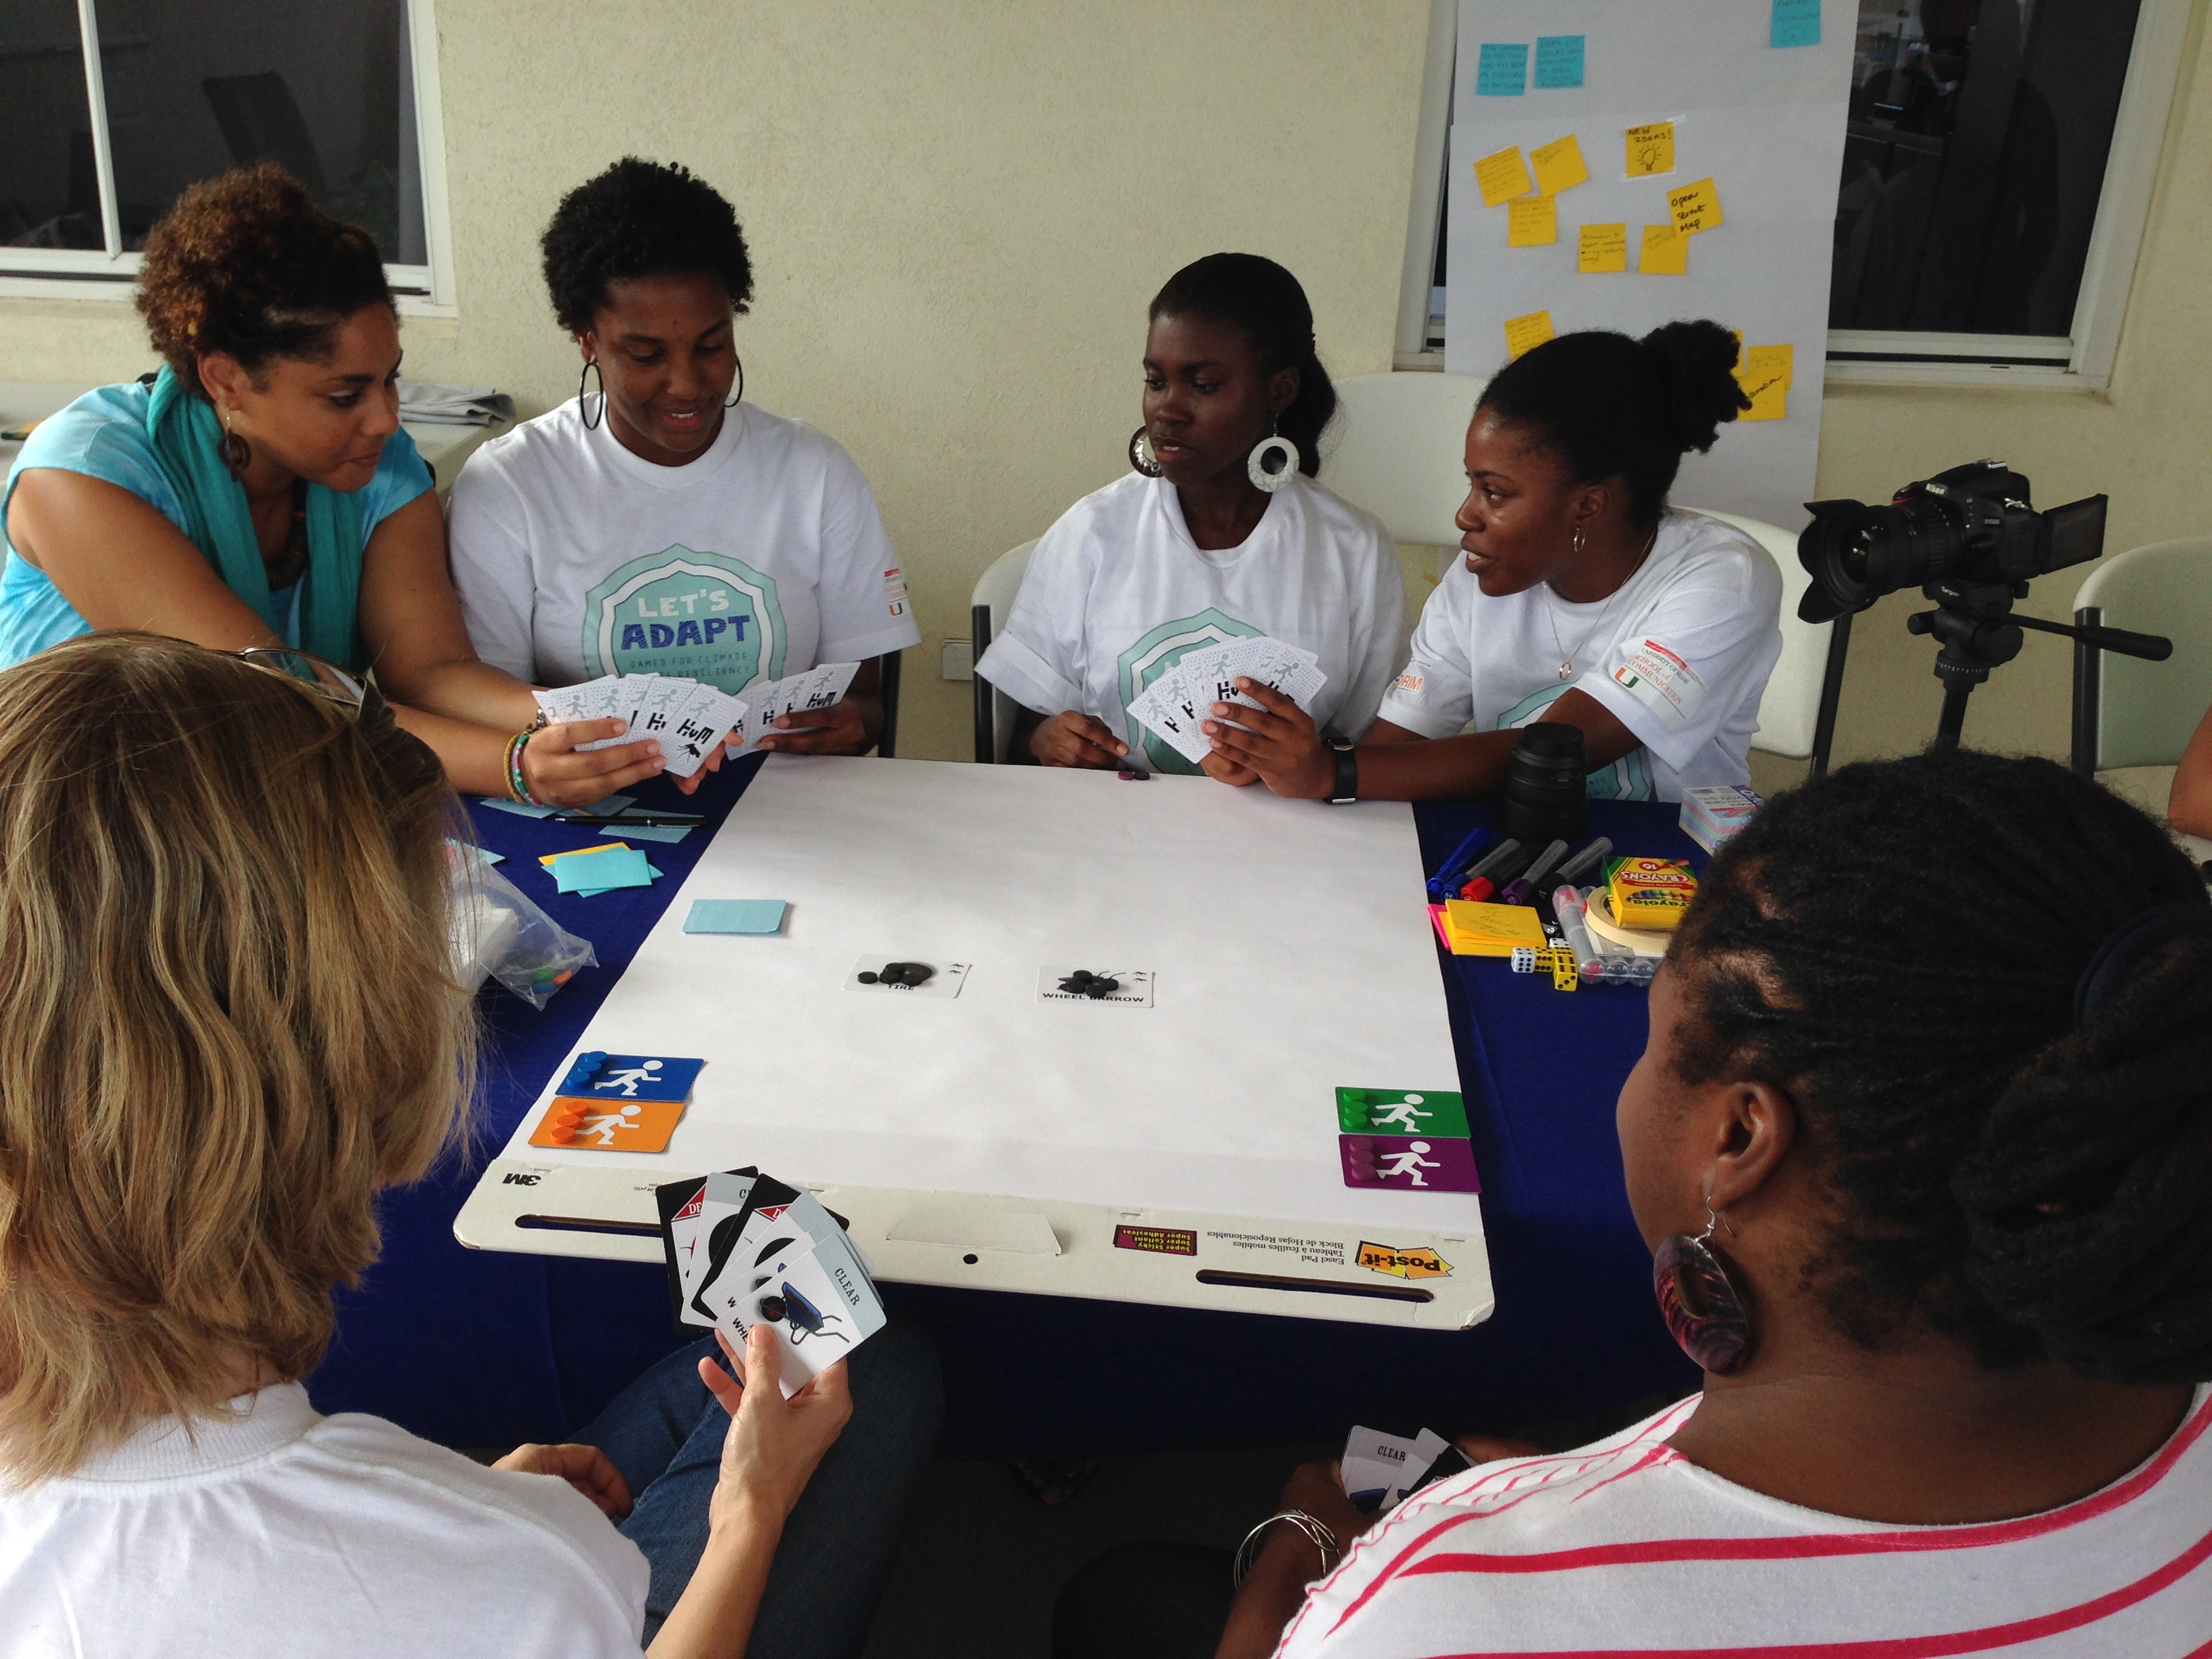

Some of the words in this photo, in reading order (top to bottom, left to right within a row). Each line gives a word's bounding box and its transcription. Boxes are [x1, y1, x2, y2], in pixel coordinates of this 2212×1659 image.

[638, 589, 730, 617] LET'S
[621, 615, 750, 651] ADAPT
[630, 659, 666, 669] GAMES
[672, 657, 693, 665] FOR
[698, 653, 747, 663] CLIMATE
[1641, 647, 1671, 666] UNIVERSITY
[678, 665, 750, 678] RESILIENCY
[1633, 655, 1662, 675] SCHOOL
[1627, 659, 1683, 704] COMMUNICATION
[1620, 871, 1688, 882] CRAYONS
[502, 1173, 541, 1186] 3M
[1122, 1229, 1164, 1237] Adhesivas
[1207, 1231, 1275, 1244] Reposicionables
[1233, 1241, 1266, 1249] mobiles
[1278, 1237, 1303, 1246] Hojas
[1269, 1244, 1299, 1253] feuilles
[1310, 1248, 1345, 1257] Tableau
[1321, 1256, 1345, 1265] Easel
[1364, 1254, 1441, 1271] Post-it
[834, 1267, 861, 1306] CLEAR
[1377, 1445, 1406, 1462] CLEAR
